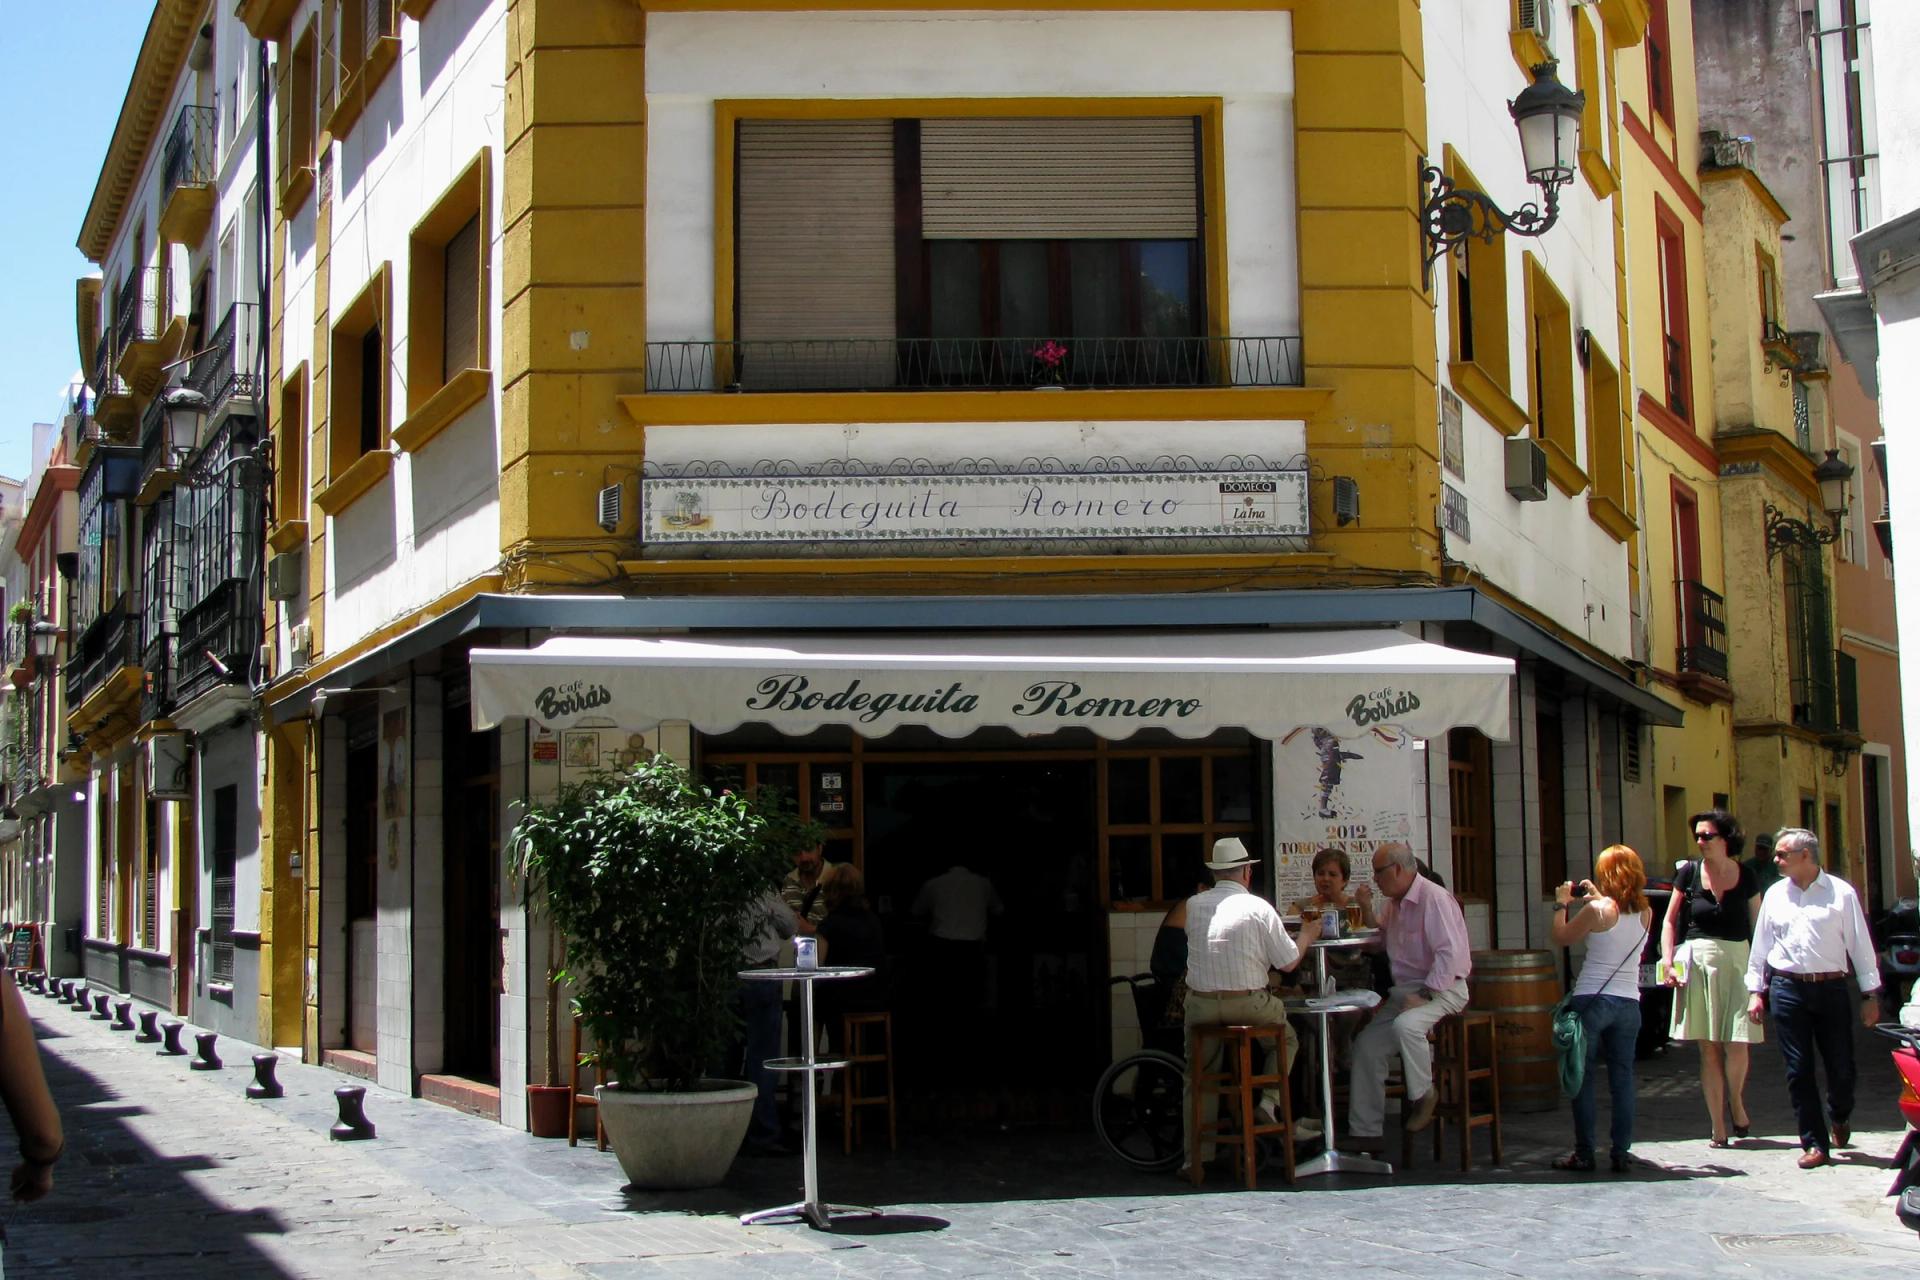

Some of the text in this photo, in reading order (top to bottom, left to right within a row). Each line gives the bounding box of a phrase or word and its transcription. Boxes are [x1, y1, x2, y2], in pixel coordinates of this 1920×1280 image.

[1224, 483, 1272, 492] DOMECQ
[751, 485, 1184, 529] Bodeguita Romero
[1233, 507, 1266, 519] La Ina
[559, 679, 583, 694] Café
[1368, 686, 1392, 701] Café
[535, 684, 611, 720] Borrás
[746, 673, 1203, 723] Bodeguita Romero
[1345, 690, 1420, 726] Borrás
[1326, 824, 1367, 839] 2012
[1279, 841, 1324, 855] TOROS
